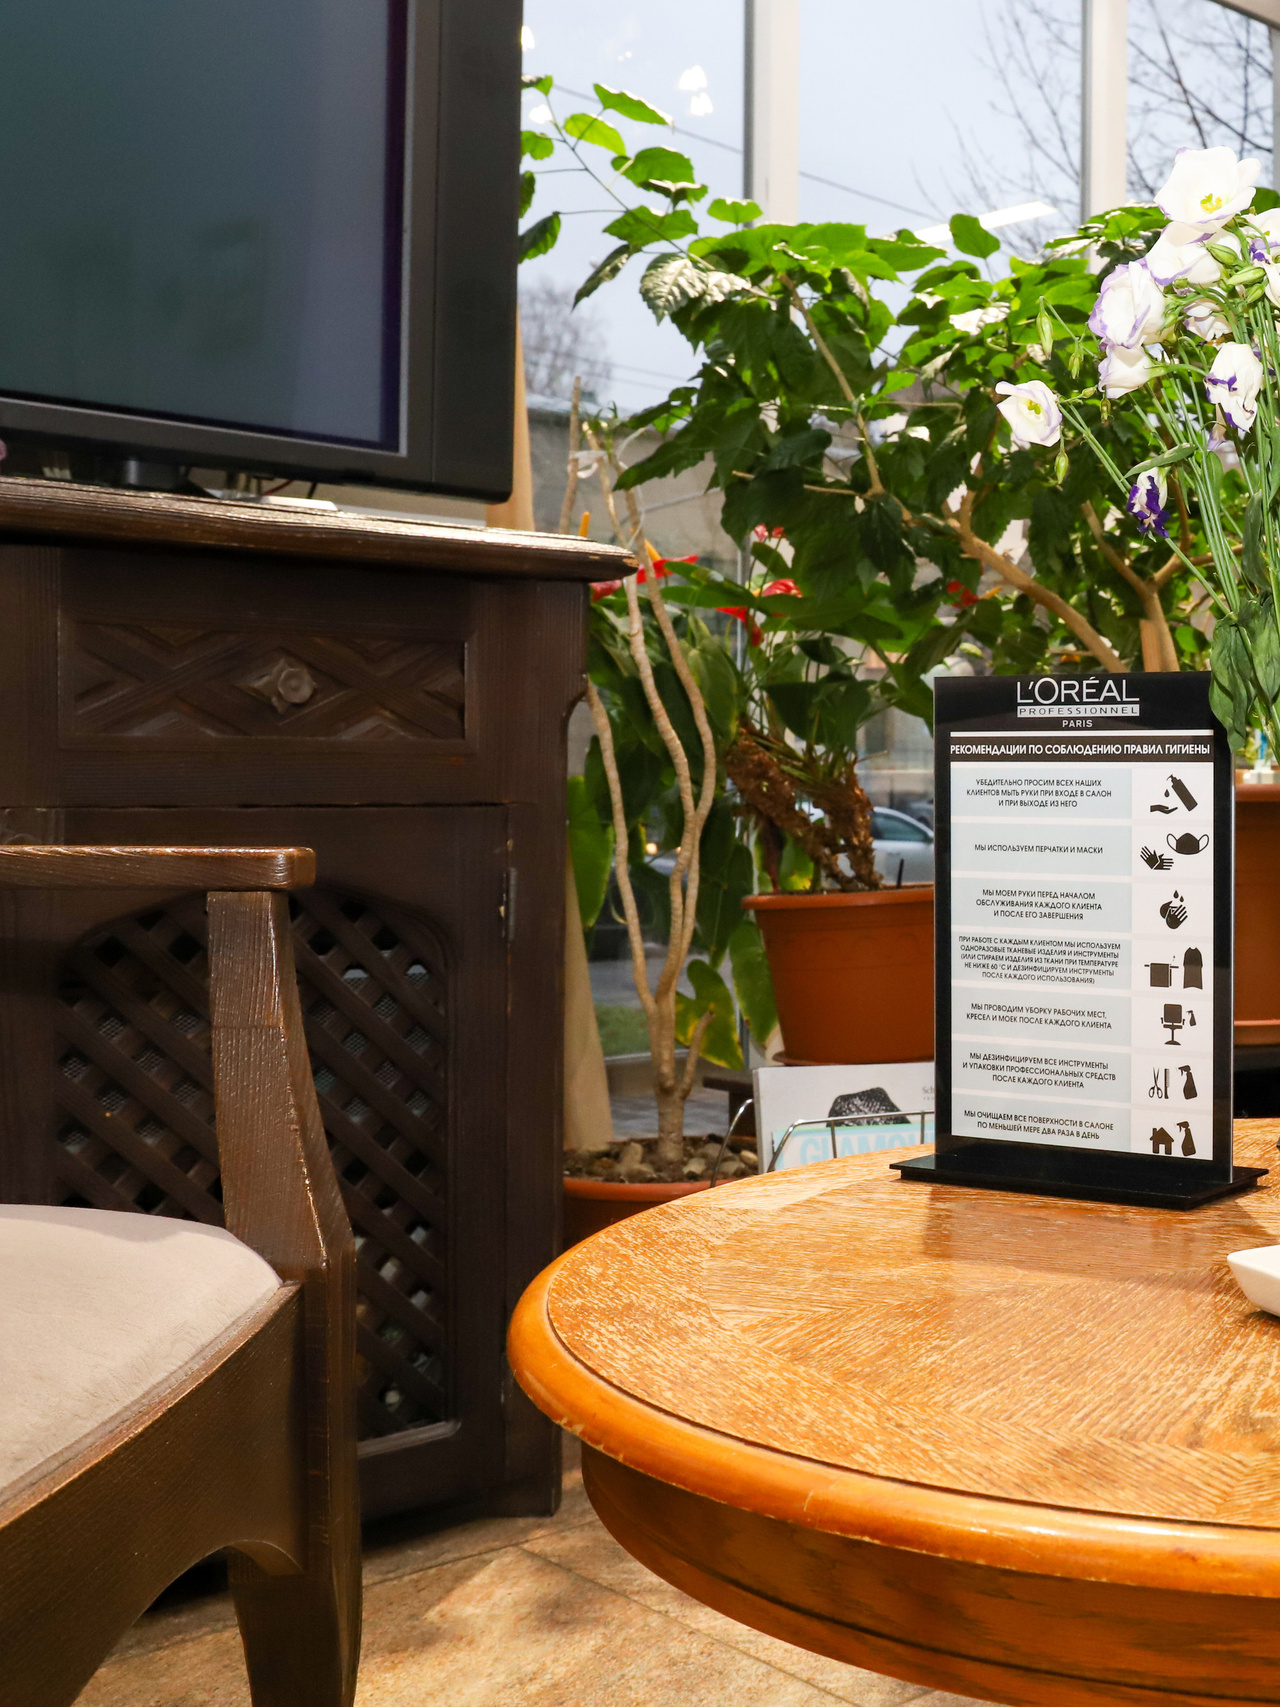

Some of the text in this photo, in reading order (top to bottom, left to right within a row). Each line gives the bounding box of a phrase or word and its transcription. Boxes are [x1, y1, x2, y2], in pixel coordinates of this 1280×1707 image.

[1019, 706, 1138, 716] PROFESSIONNEL
[1062, 719, 1092, 727] PARIS
[950, 744, 1210, 755] РЕКОМЕНДАЦИИ ПО СОБЛЮДЕНИЮ ПРАВИЛ ГИГИЕНЫ
[975, 778, 1022, 786] УБЕДИТЕЛЬНО
[1024, 778, 1054, 786] ПРОСИМ
[966, 788, 999, 796] КЛИЕНТОВ
[1054, 789, 1078, 797] ВХОДЕ
[1079, 789, 1084, 797] В
[1085, 789, 1111, 797] САЛОН
[1019, 799, 1048, 808] ВЫХОДЕ
[1049, 799, 1059, 807] ИЗ
[987, 844, 1034, 852] ИСПОЛЬЗУЕМ
[1035, 845, 1068, 853] ПЕРЧАТКИ
[1076, 846, 1103, 854] МАСКИ
[995, 889, 1016, 897] МОЕМ
[1037, 890, 1058, 899] ПЕРЕД
[1059, 891, 1095, 900] НАЧАЛОМ
[975, 898, 1102, 910] ОБСЛУЖИВАНИЯ КАЖДОГО КЛИЕНТА
[1000, 909, 1023, 918] ПОСЛЕ
[1025, 910, 1037, 918] ЕГО
[1038, 911, 1083, 920] ЗАВЕРШЕНИЯ
[1030, 939, 1063, 947] КЛИЕНТОМ
[1076, 941, 1120, 949] ИСПОЛЬЗУЕМ
[960, 944, 1005, 953] ОДНОРАЗОВЫЕ
[1006, 946, 1036, 954] ТКАНЕВЫЕ
[1037, 948, 1066, 956] ИЗДЕЛИЯ
[1073, 950, 1119, 959] ИНСТРУМЕНТЫ
[1005, 955, 1033, 963] ИЗДЕЛИЯ
[1078, 959, 1118, 967] ТЕМПЕРАТУРЕ
[972, 962, 989, 970] НИЖЕ
[1012, 964, 1067, 973] ДЕЗИНФИЦИРУЕМ
[1068, 967, 1114, 976] ИНСТРУМЕНТЫ
[981, 971, 1095, 984] ПОСЛЕ КАЖДОГО ИСПОЛЬЗОВАНИЯ)
[970, 1002, 982, 1010] МЫ
[984, 1003, 1023, 1013] ПРОВОДИМ
[1025, 1006, 1052, 1014] УБОРКУ
[1053, 1008, 1085, 1017] РАБОЧИХ
[966, 1012, 990, 1021] КРЕСЕЛ
[998, 1014, 1017, 1022] МОЕК
[1019, 1016, 1042, 1024] ПОСЛЕ
[1044, 1018, 1080, 1027] КАЖДОГО
[1081, 1020, 1112, 1029] КЛИЕНТА
[982, 1053, 1042, 1064] ДЕЗИНФИЦИРУЕМ
[1044, 1057, 1056, 1066] ВСЕ
[1058, 1059, 1108, 1069] ИНСТРУМЕНТЫ
[968, 1062, 1004, 1071] УПАКОВКИ
[1005, 1065, 1083, 1078] ПРОФЕССИОНАЛЬНЫХ
[1084, 1071, 1116, 1081] СРЕДСТВ
[992, 1074, 1084, 1088] ПОСЛЕ КАЖДОГО КЛИЕНТА
[963, 1109, 975, 1117] МЫ
[976, 1110, 1013, 1122] ОЧИЩАЕМ
[1013, 1114, 1026, 1122] ВСЕ
[1028, 1115, 1077, 1126] ПОВЕРХНОСТИ
[1084, 1121, 1113, 1130] САЛОНЕ
[977, 1120, 987, 1128] ПО
[988, 1122, 1022, 1131] МЕНЬШЕЙ
[1023, 1125, 1040, 1133] МЕРЕ
[1041, 1127, 1056, 1135] ДВА
[1057, 1128, 1074, 1136] РАЗА
[1081, 1131, 1100, 1139] ДЕНЬ
